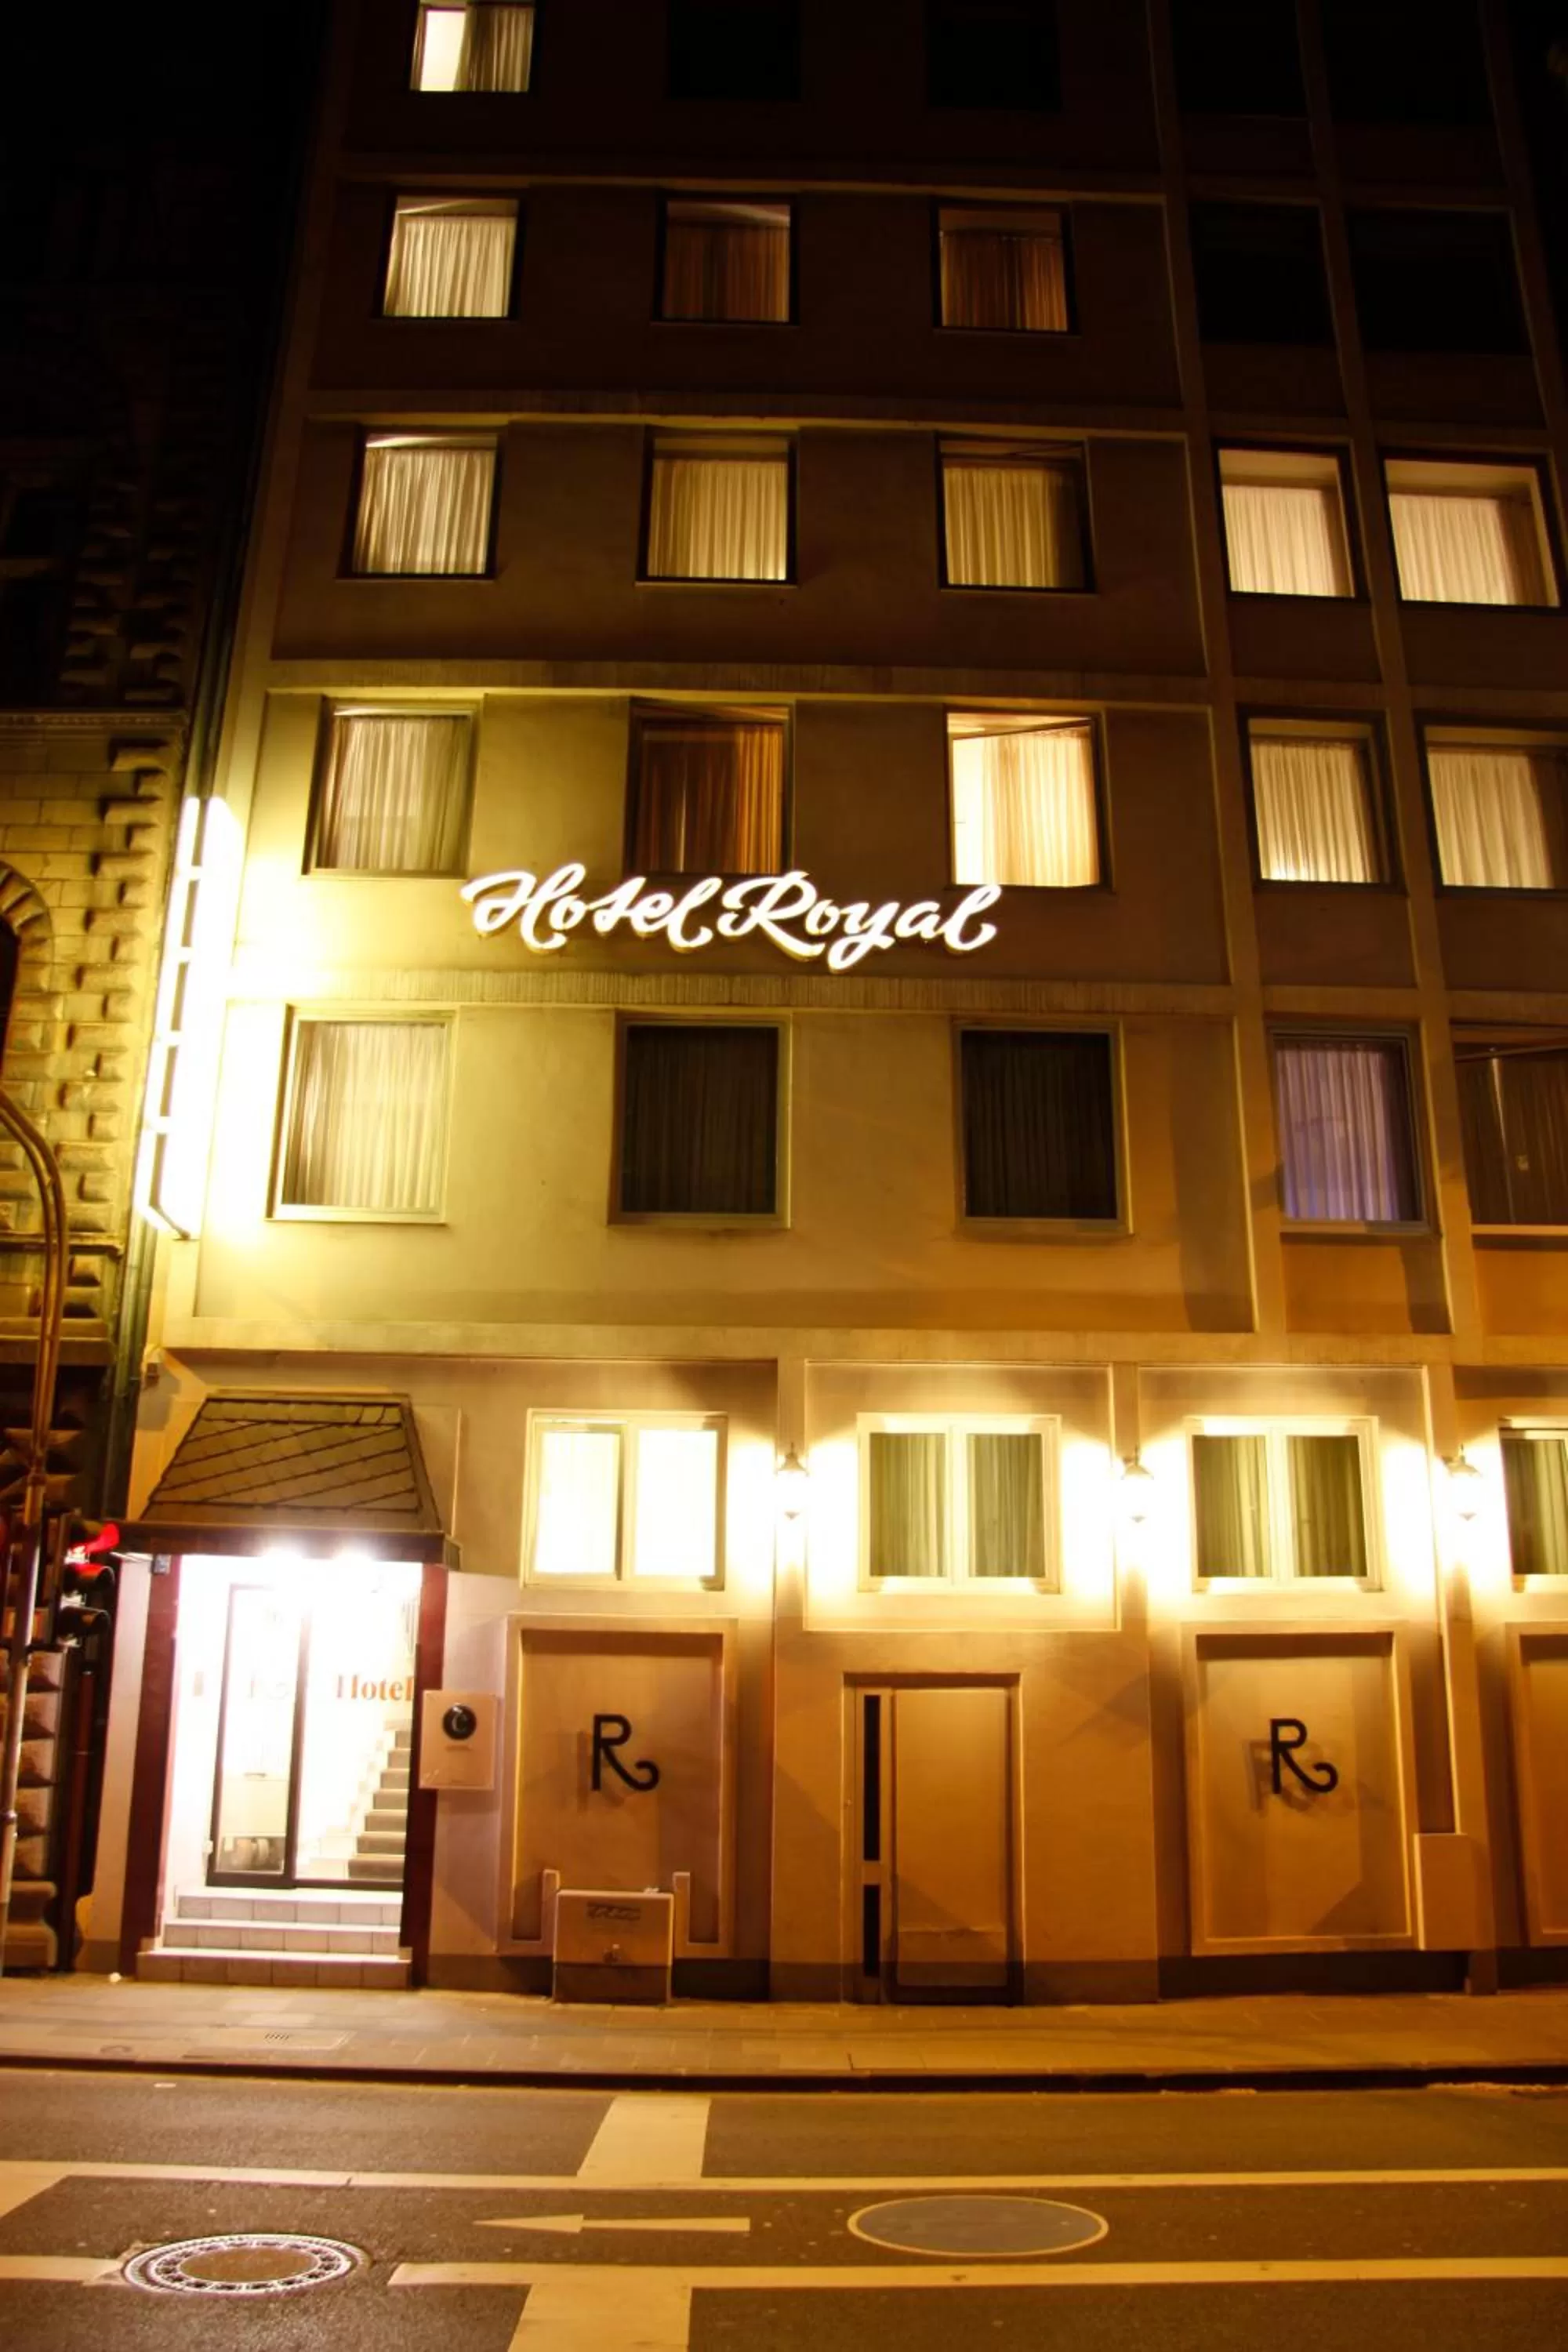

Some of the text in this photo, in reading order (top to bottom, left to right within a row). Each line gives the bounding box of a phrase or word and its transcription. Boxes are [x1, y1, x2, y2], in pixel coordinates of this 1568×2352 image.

[460, 863, 1002, 971] Hotel Royal
[336, 1674, 414, 1701] Hotel
[591, 1714, 660, 1791] R
[1270, 1718, 1338, 1795] R
